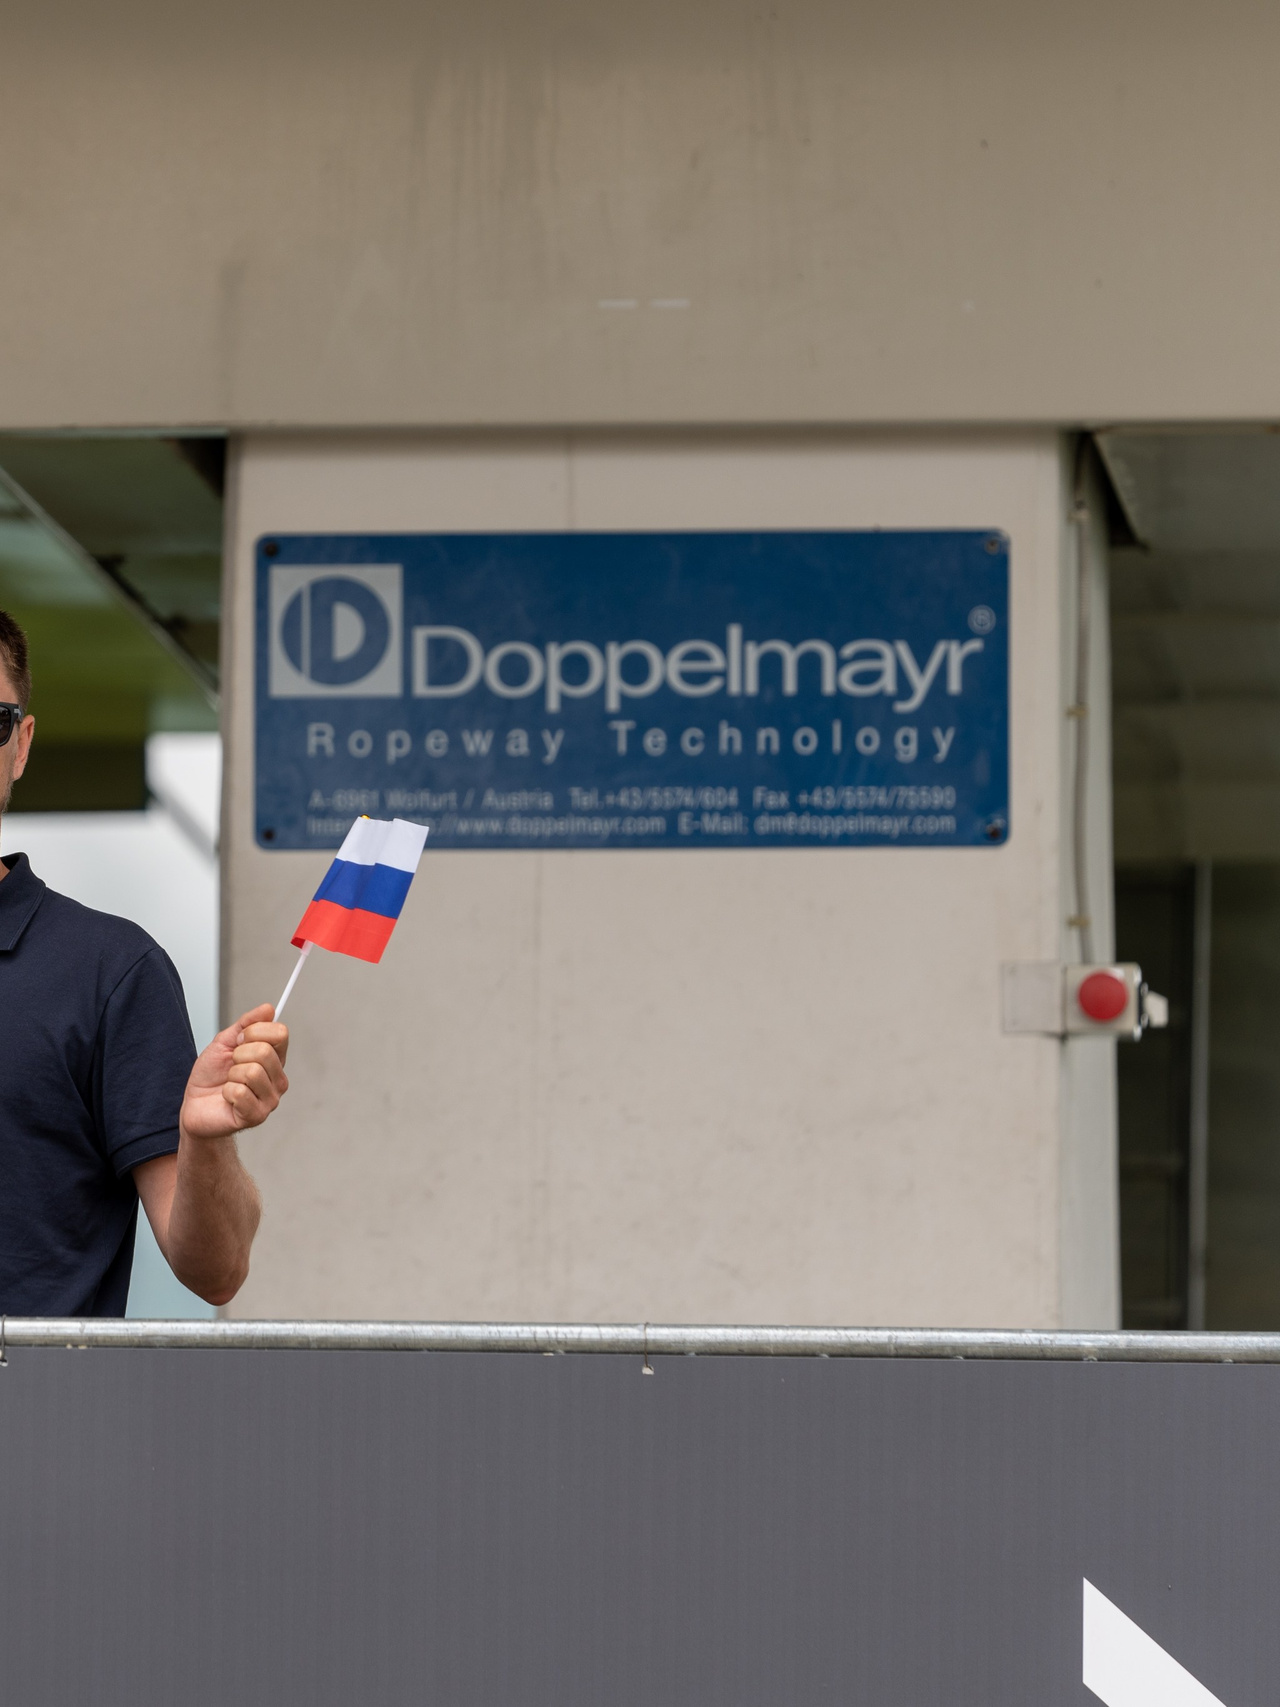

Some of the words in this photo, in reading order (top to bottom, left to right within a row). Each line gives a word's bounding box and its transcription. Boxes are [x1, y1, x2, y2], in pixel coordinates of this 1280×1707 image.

[307, 721, 565, 763] Ropeway
[609, 720, 956, 763] Technology
[481, 788, 554, 811] Austria
[754, 786, 789, 810] Fax
